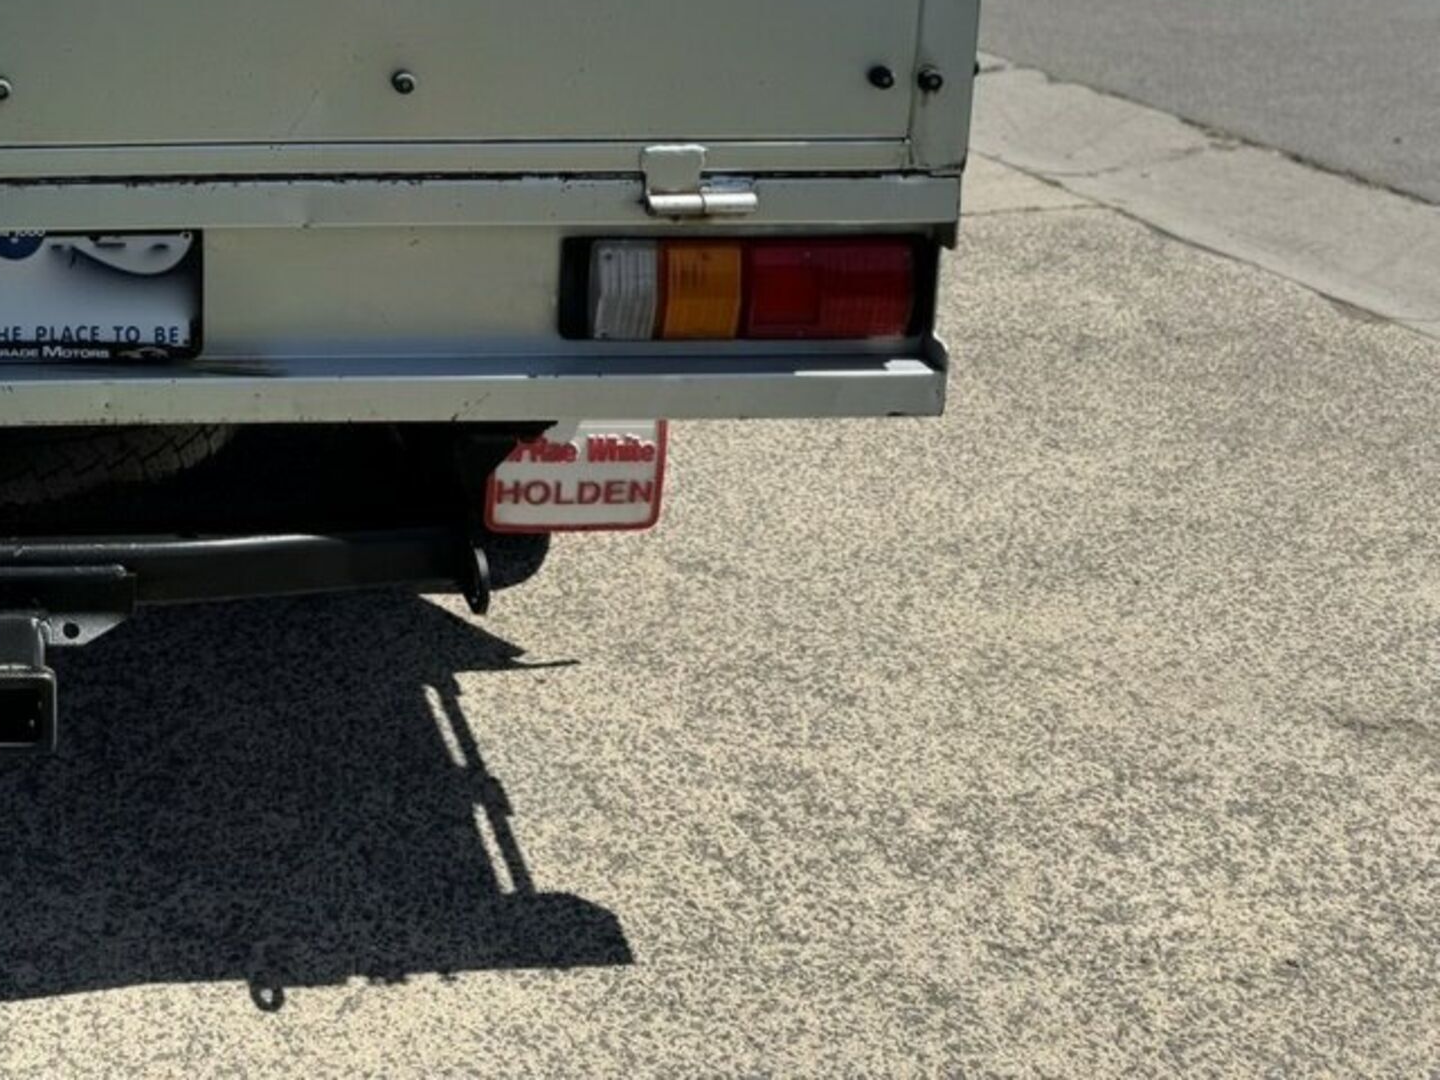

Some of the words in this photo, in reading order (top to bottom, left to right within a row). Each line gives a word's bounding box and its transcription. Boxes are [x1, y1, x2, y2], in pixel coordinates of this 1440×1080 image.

[35, 324, 101, 343] PLACE
[112, 325, 141, 343] TO
[154, 325, 180, 344] BE
[496, 479, 654, 506] HOLDEN
